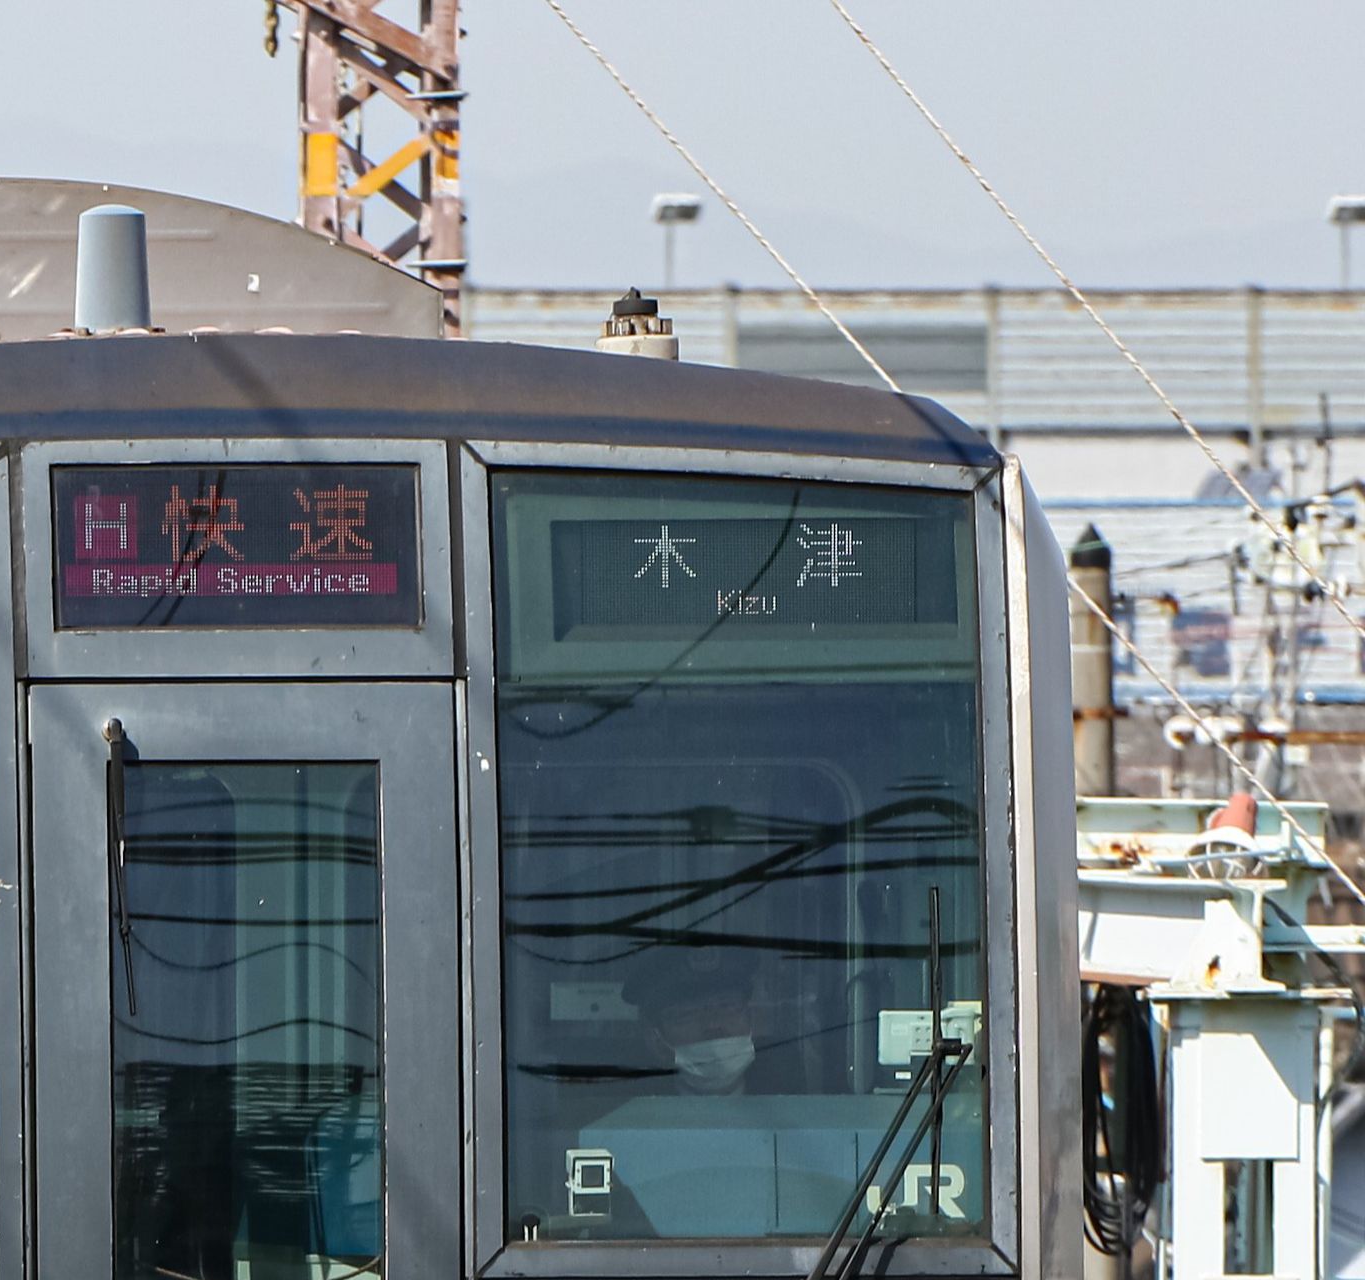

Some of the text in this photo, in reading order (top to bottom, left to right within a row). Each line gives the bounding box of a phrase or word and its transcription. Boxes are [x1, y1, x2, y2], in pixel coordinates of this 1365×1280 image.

[84, 484, 373, 562] H 快速
[92, 567, 370, 597] Rapid Service
[716, 588, 777, 615] Kizu
[866, 1163, 966, 1218] JR
